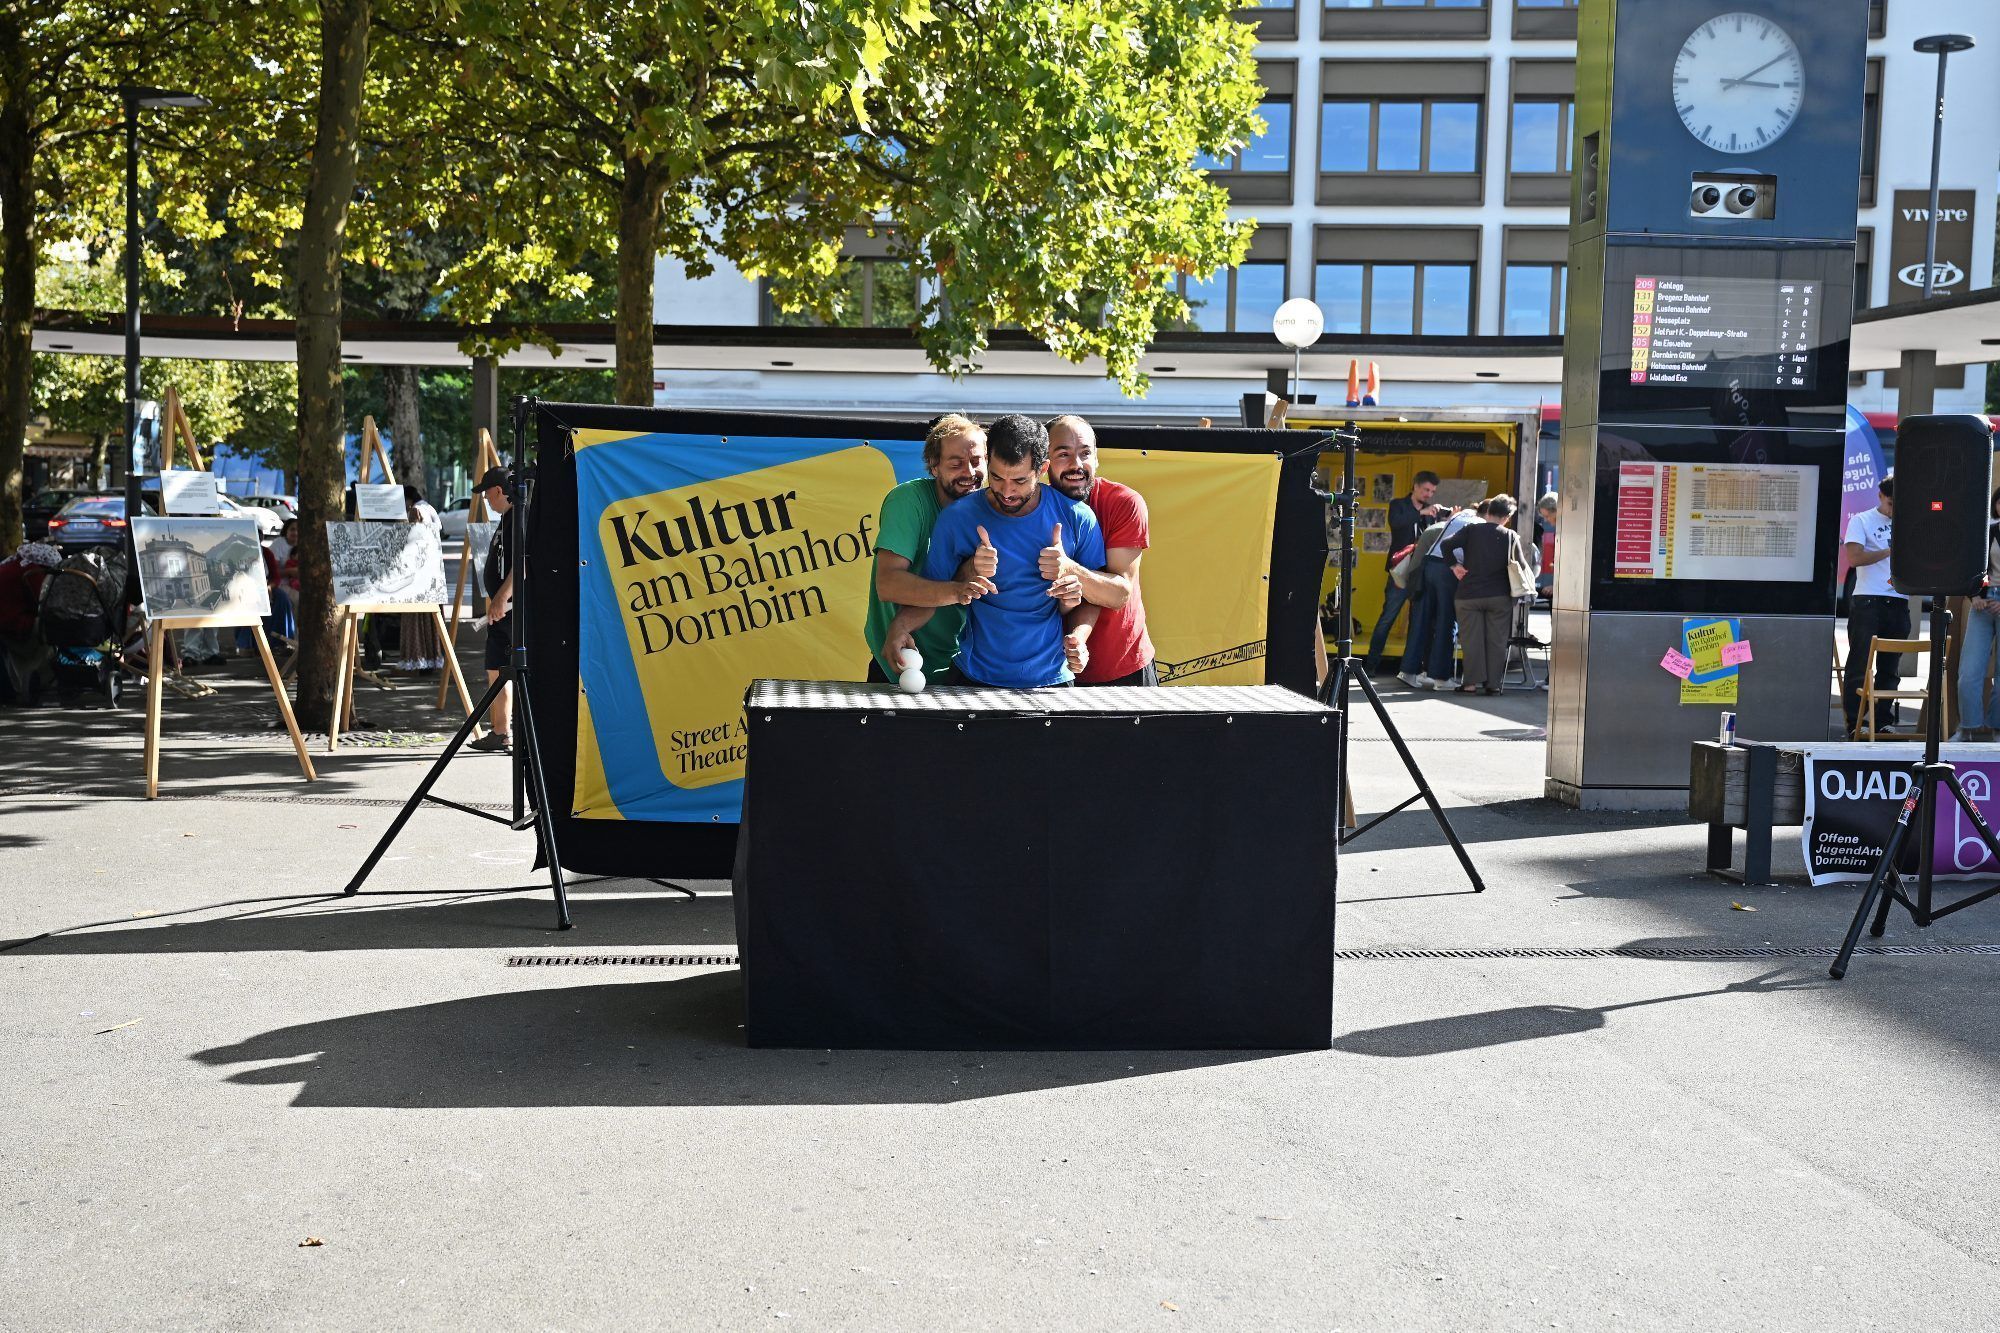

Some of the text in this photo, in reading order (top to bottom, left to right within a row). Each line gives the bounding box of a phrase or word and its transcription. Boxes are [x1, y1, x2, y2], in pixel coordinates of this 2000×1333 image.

[1902, 208, 1968, 222] vivere
[1636, 280, 1653, 289] 209
[1658, 281, 1684, 291] Kehlegg
[1636, 292, 1651, 300] 131
[1657, 293, 1683, 302] Bregenz
[1683, 294, 1709, 302] Bahnhof
[1804, 297, 1810, 305] B
[1635, 304, 1650, 312] 162
[1656, 305, 1684, 313] Lustenau
[1685, 305, 1711, 313] Bahnhof
[1802, 309, 1808, 317] A
[1633, 315, 1649, 323] 211
[1655, 316, 1691, 326] Messeplatz
[1801, 320, 1807, 328] C
[1633, 326, 1648, 334] 152
[1800, 332, 1806, 340] A
[1632, 338, 1647, 346] 205
[1653, 339, 1662, 347] Am
[1796, 343, 1807, 351] Ost
[1652, 351, 1678, 359] Dornbirn
[1792, 354, 1807, 362] West
[1632, 361, 1645, 369] 81
[1681, 363, 1707, 371] Bahnhof
[1796, 366, 1802, 374] B
[1650, 373, 1675, 382] Waldbad
[1676, 374, 1687, 382] Enz
[608, 490, 796, 568] Kultur
[627, 514, 874, 613] am Bahnhof
[634, 585, 828, 655] Dornbirn
[1687, 627, 1716, 641] Kultur
[1700, 631, 1727, 646] Bahnhof
[671, 716, 748, 752] Street A
[676, 744, 747, 774] Theate
[1820, 770, 1912, 800] OJAD
[1818, 832, 1859, 844] Offene
[1816, 844, 1883, 857] JugendArb
[1815, 855, 1867, 867] Dornbirn
